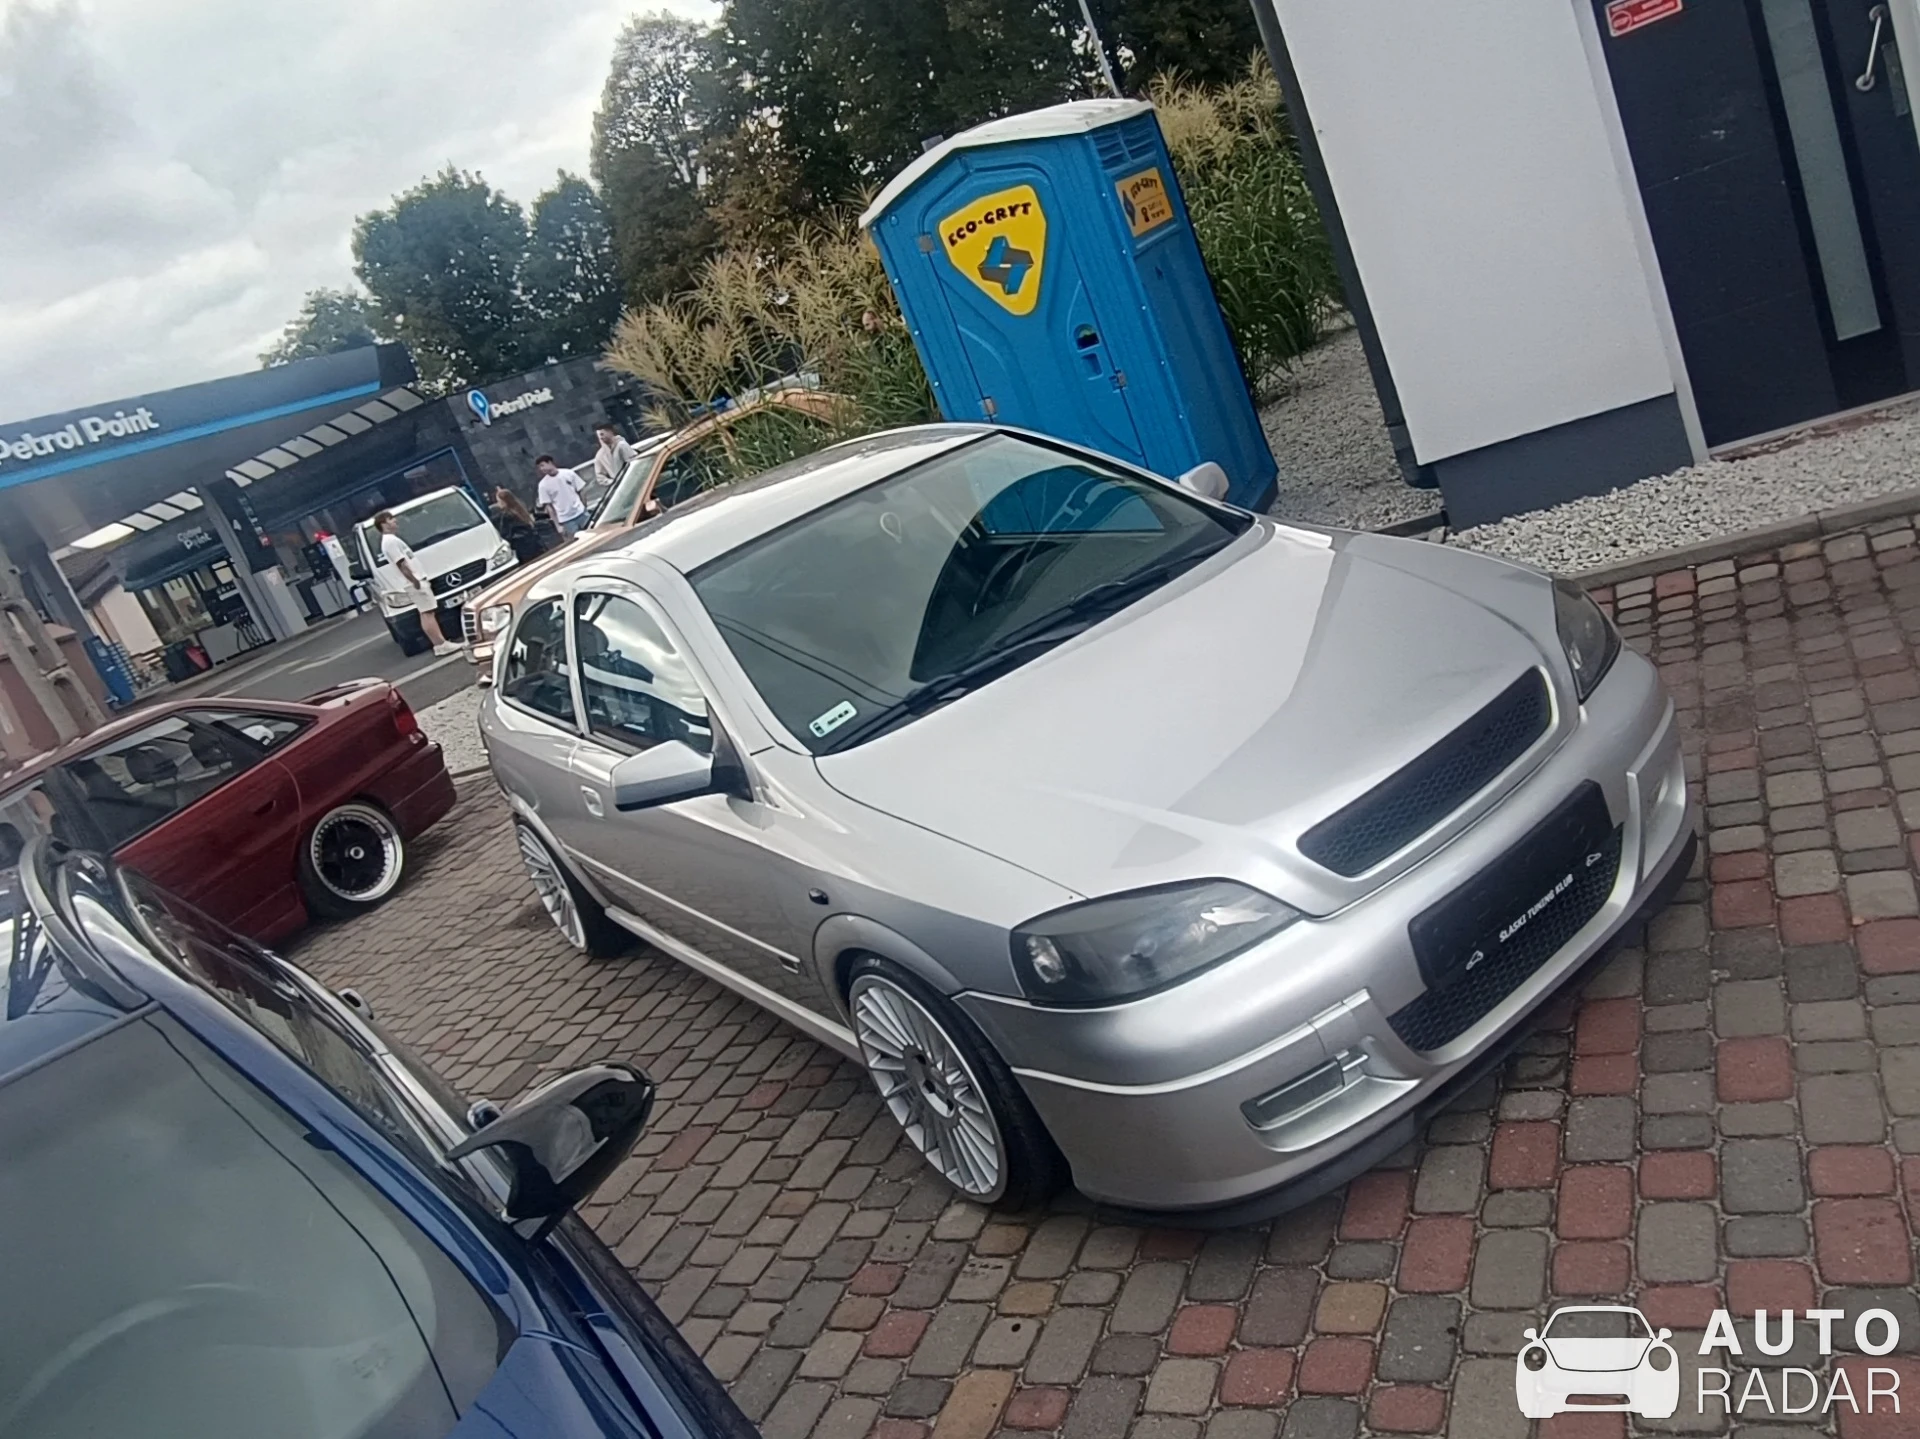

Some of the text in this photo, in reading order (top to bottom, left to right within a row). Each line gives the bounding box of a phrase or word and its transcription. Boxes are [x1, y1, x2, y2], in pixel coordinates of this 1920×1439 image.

[490, 387, 554, 418] Petrol Point
[79, 407, 160, 443] Point
[1527, 889, 1555, 919] TUNING
[1554, 873, 1574, 895] KLUB
